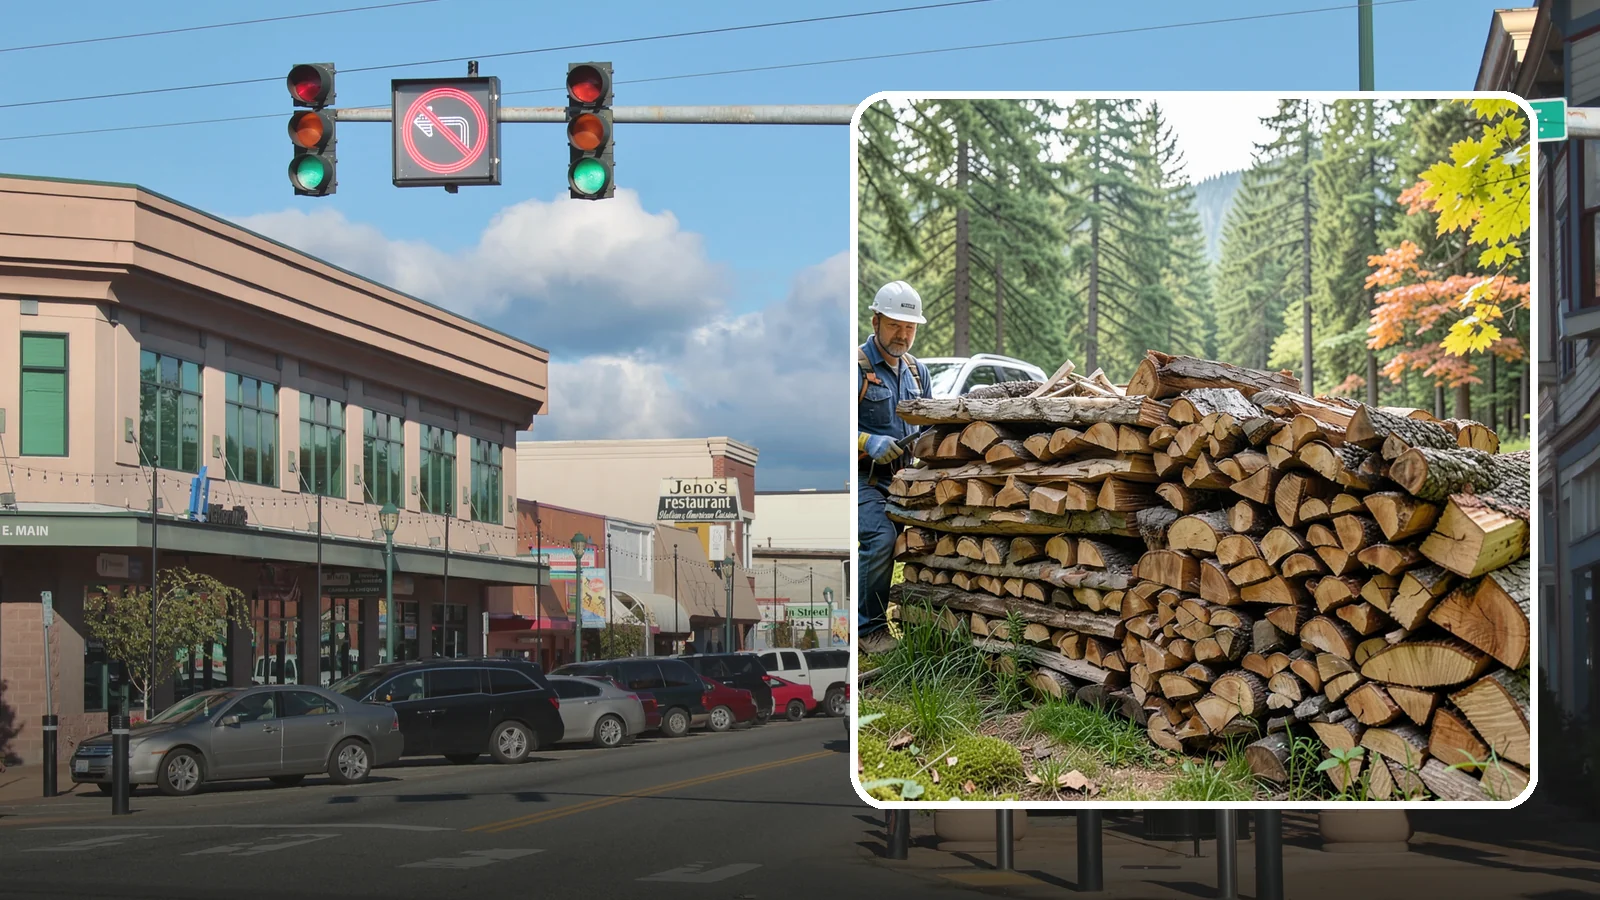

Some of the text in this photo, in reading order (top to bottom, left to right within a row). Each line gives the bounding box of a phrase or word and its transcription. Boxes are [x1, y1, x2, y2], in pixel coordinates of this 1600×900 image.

[669, 480, 727, 494] Jeno's
[665, 496, 731, 509] restaurant
[658, 510, 681, 519] Italian
[686, 510, 715, 519] American
[715, 510, 737, 519] Cuisine
[2, 525, 49, 536] E. MAIN
[797, 608, 828, 617] Street
[790, 619, 824, 627] lass
